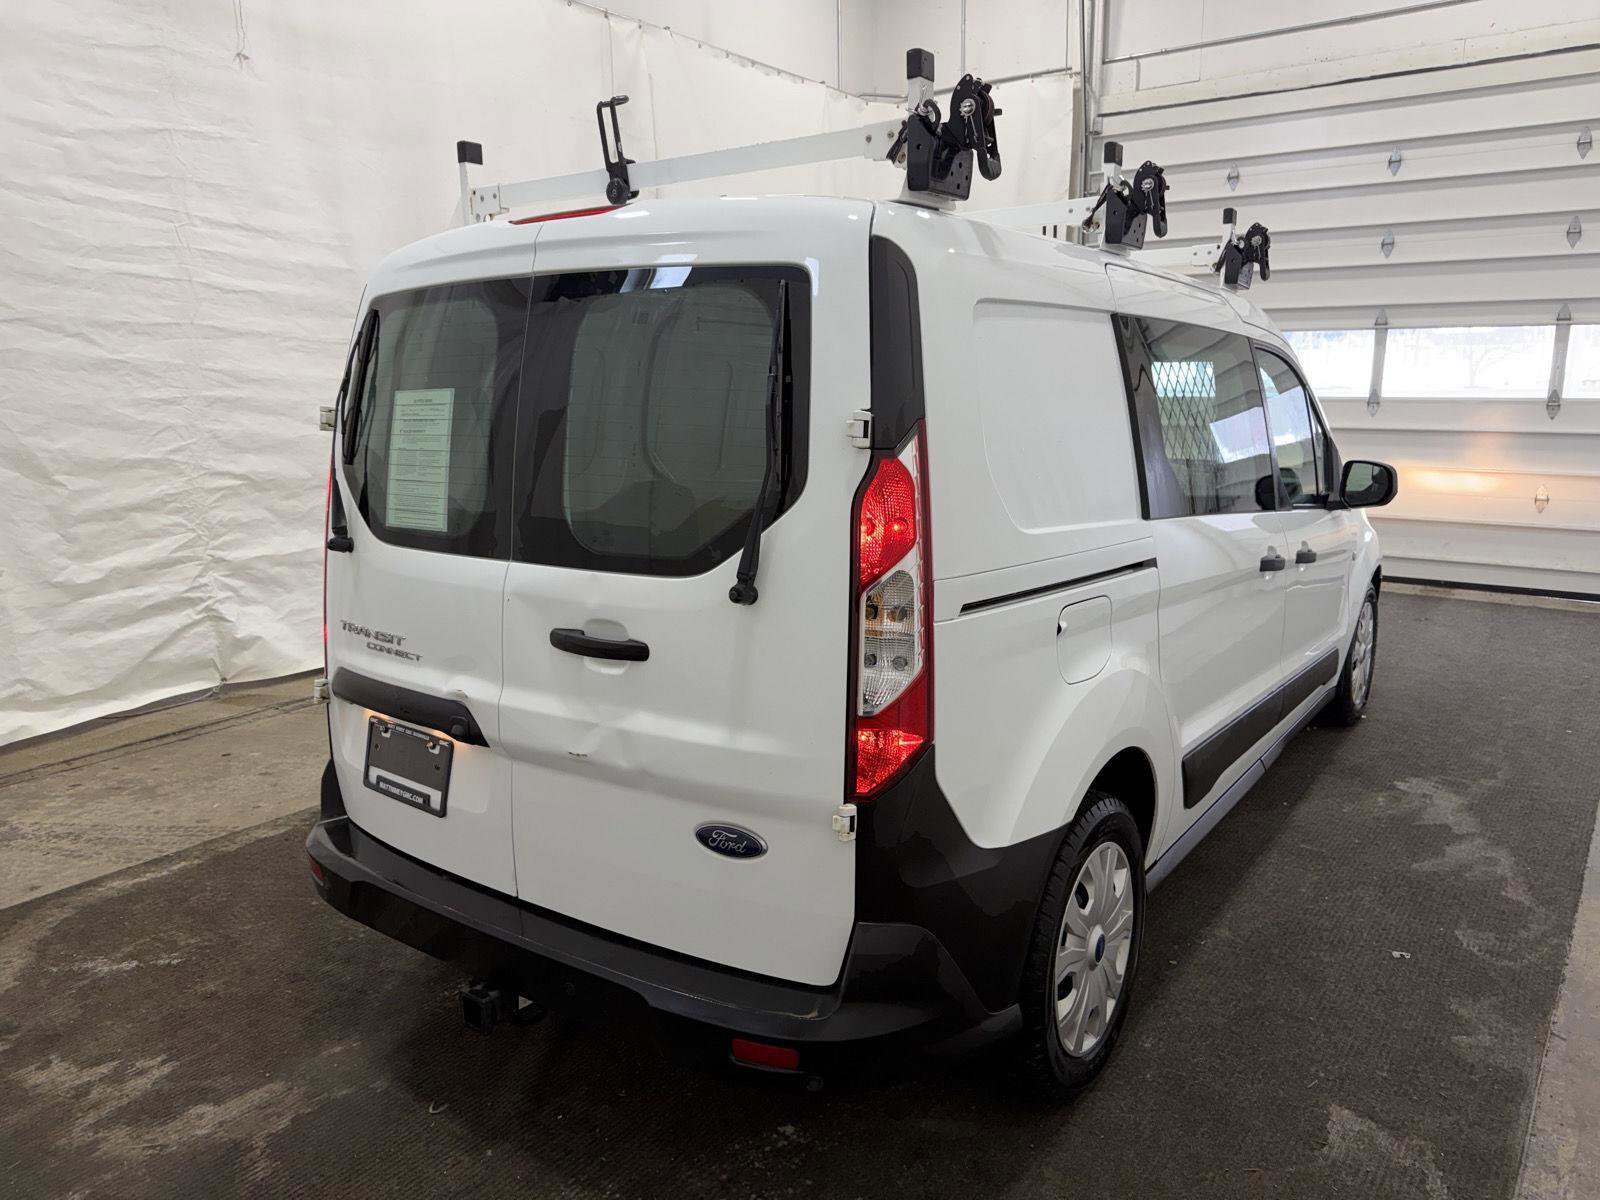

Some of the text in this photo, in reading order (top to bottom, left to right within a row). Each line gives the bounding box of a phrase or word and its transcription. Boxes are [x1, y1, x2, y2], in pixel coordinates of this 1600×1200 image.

[340, 619, 406, 646] TRANSIT
[366, 641, 423, 661] CONNECT
[708, 829, 747, 853] Ford
